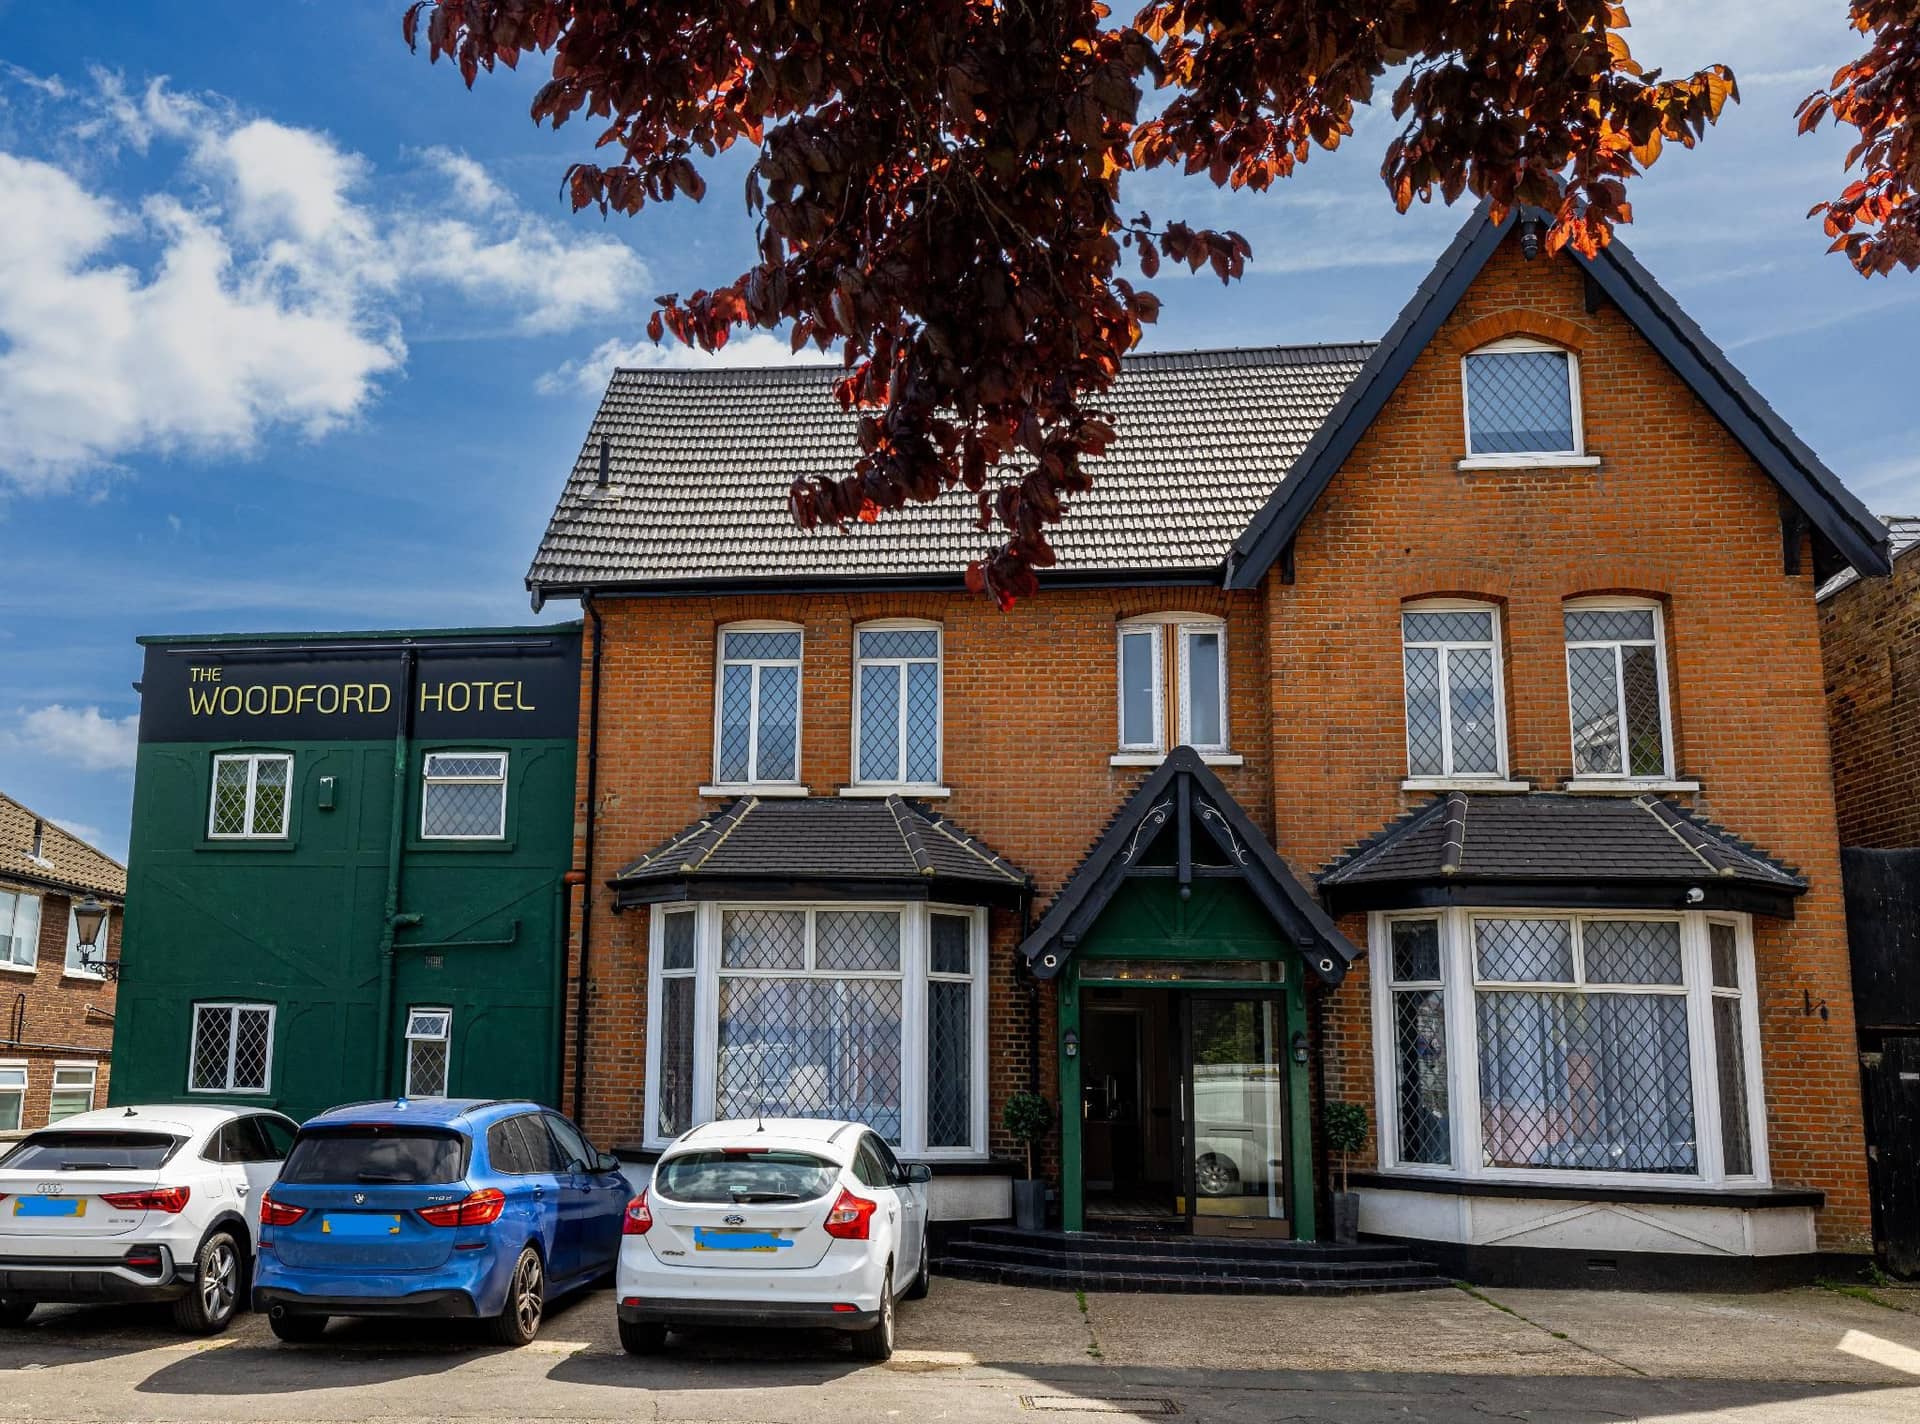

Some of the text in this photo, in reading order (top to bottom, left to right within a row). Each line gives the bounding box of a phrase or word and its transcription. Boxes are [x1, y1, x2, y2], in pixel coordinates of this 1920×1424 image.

[190, 667, 222, 682] THE
[189, 681, 536, 715] WOODFORD HOTEL
